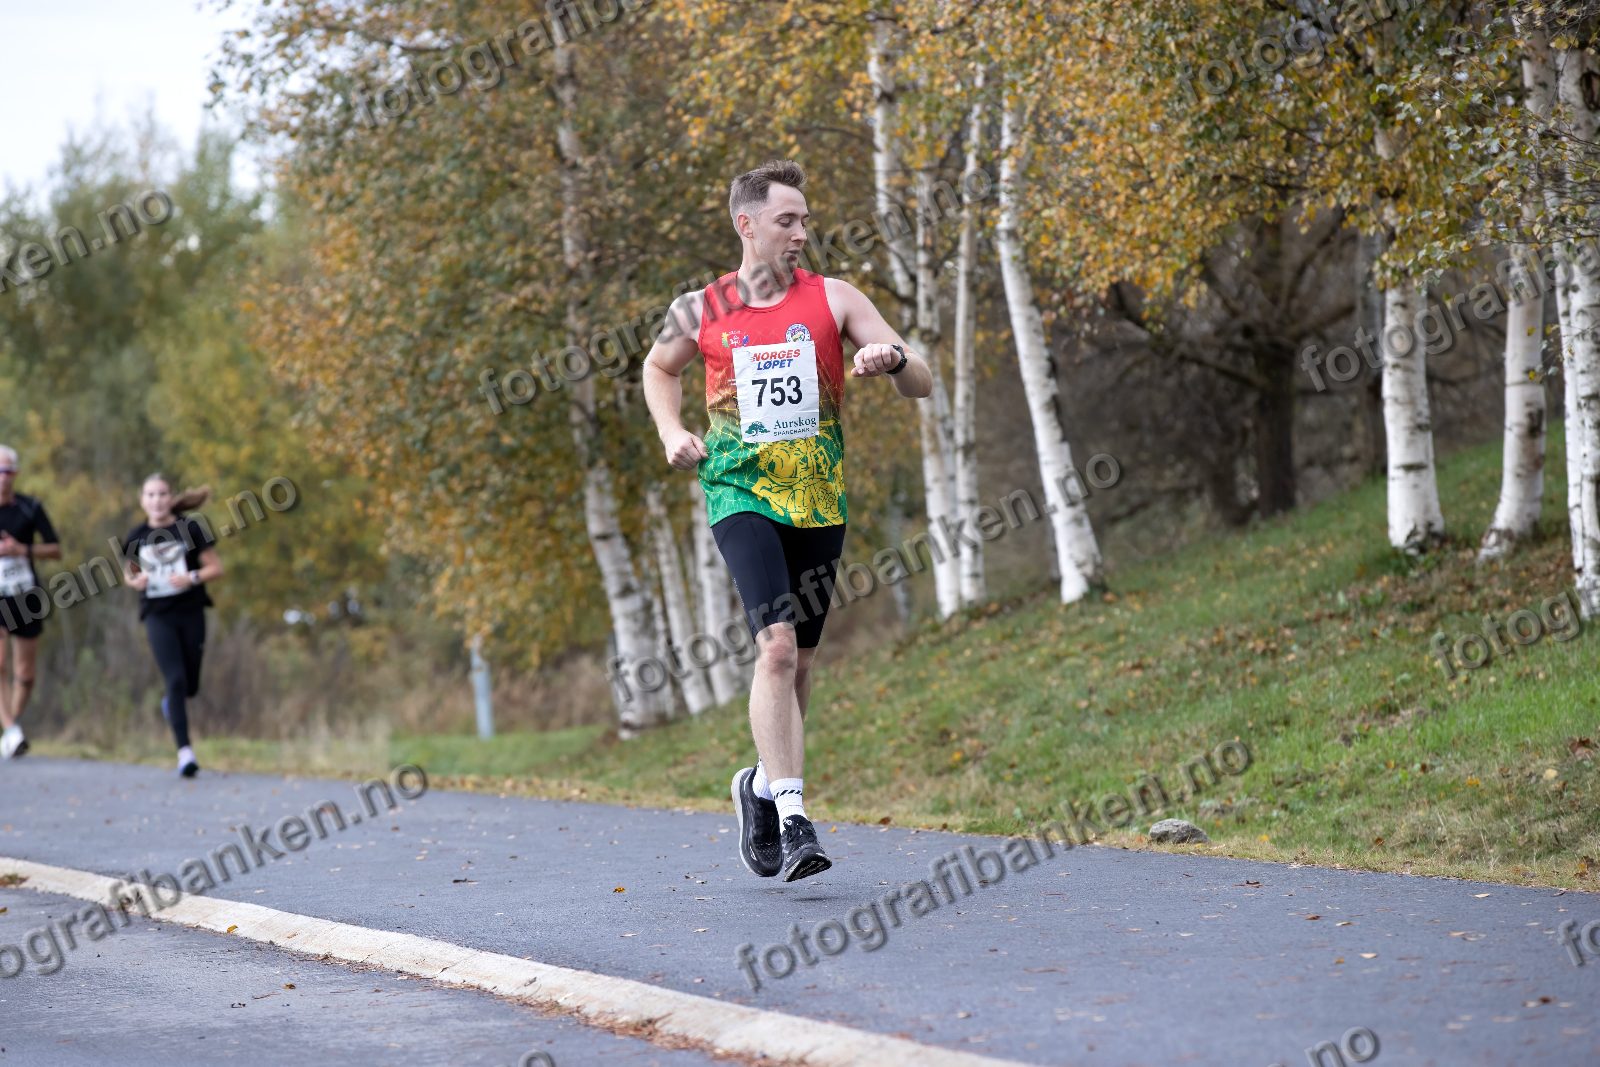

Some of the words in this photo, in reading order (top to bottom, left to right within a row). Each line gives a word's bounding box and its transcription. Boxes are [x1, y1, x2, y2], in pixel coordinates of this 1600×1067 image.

[751, 349, 800, 362] NORGES
[757, 359, 793, 370] LØPET
[752, 376, 802, 407] 753
[773, 417, 817, 429] Aurskog
